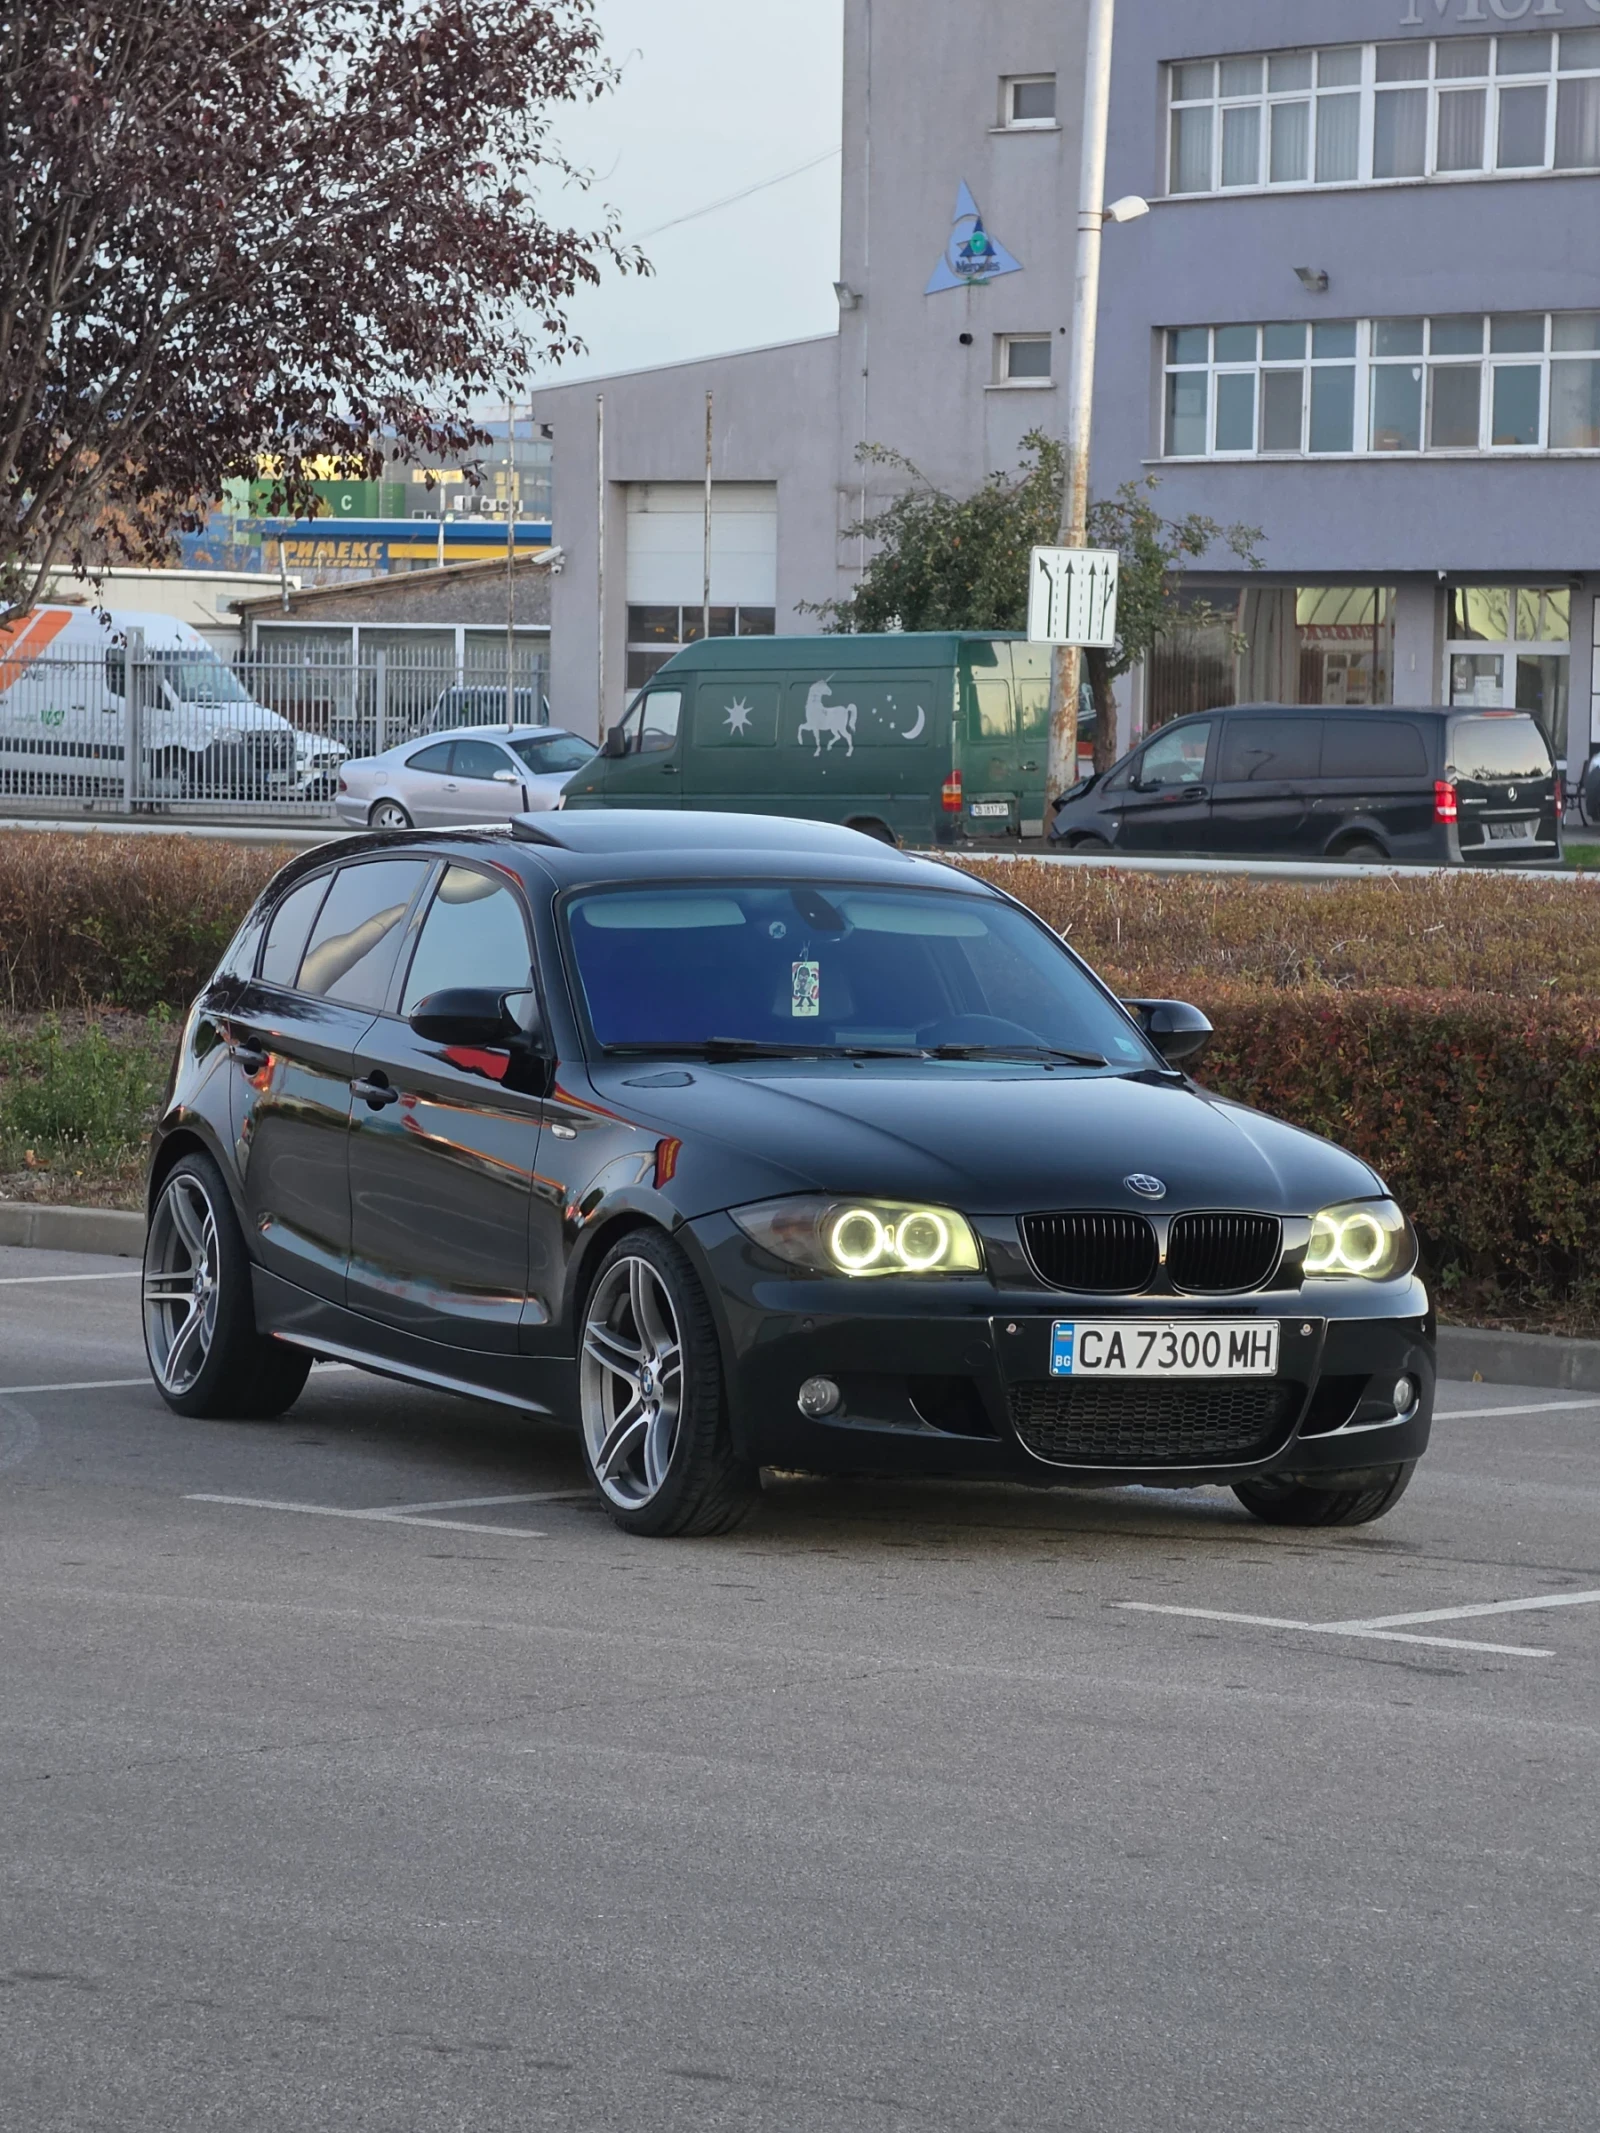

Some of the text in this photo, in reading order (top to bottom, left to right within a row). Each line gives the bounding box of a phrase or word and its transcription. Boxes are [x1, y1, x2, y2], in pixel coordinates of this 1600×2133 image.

[1055, 1355, 1071, 1367] BG
[1079, 1330, 1272, 1369] CA 7300 MH
